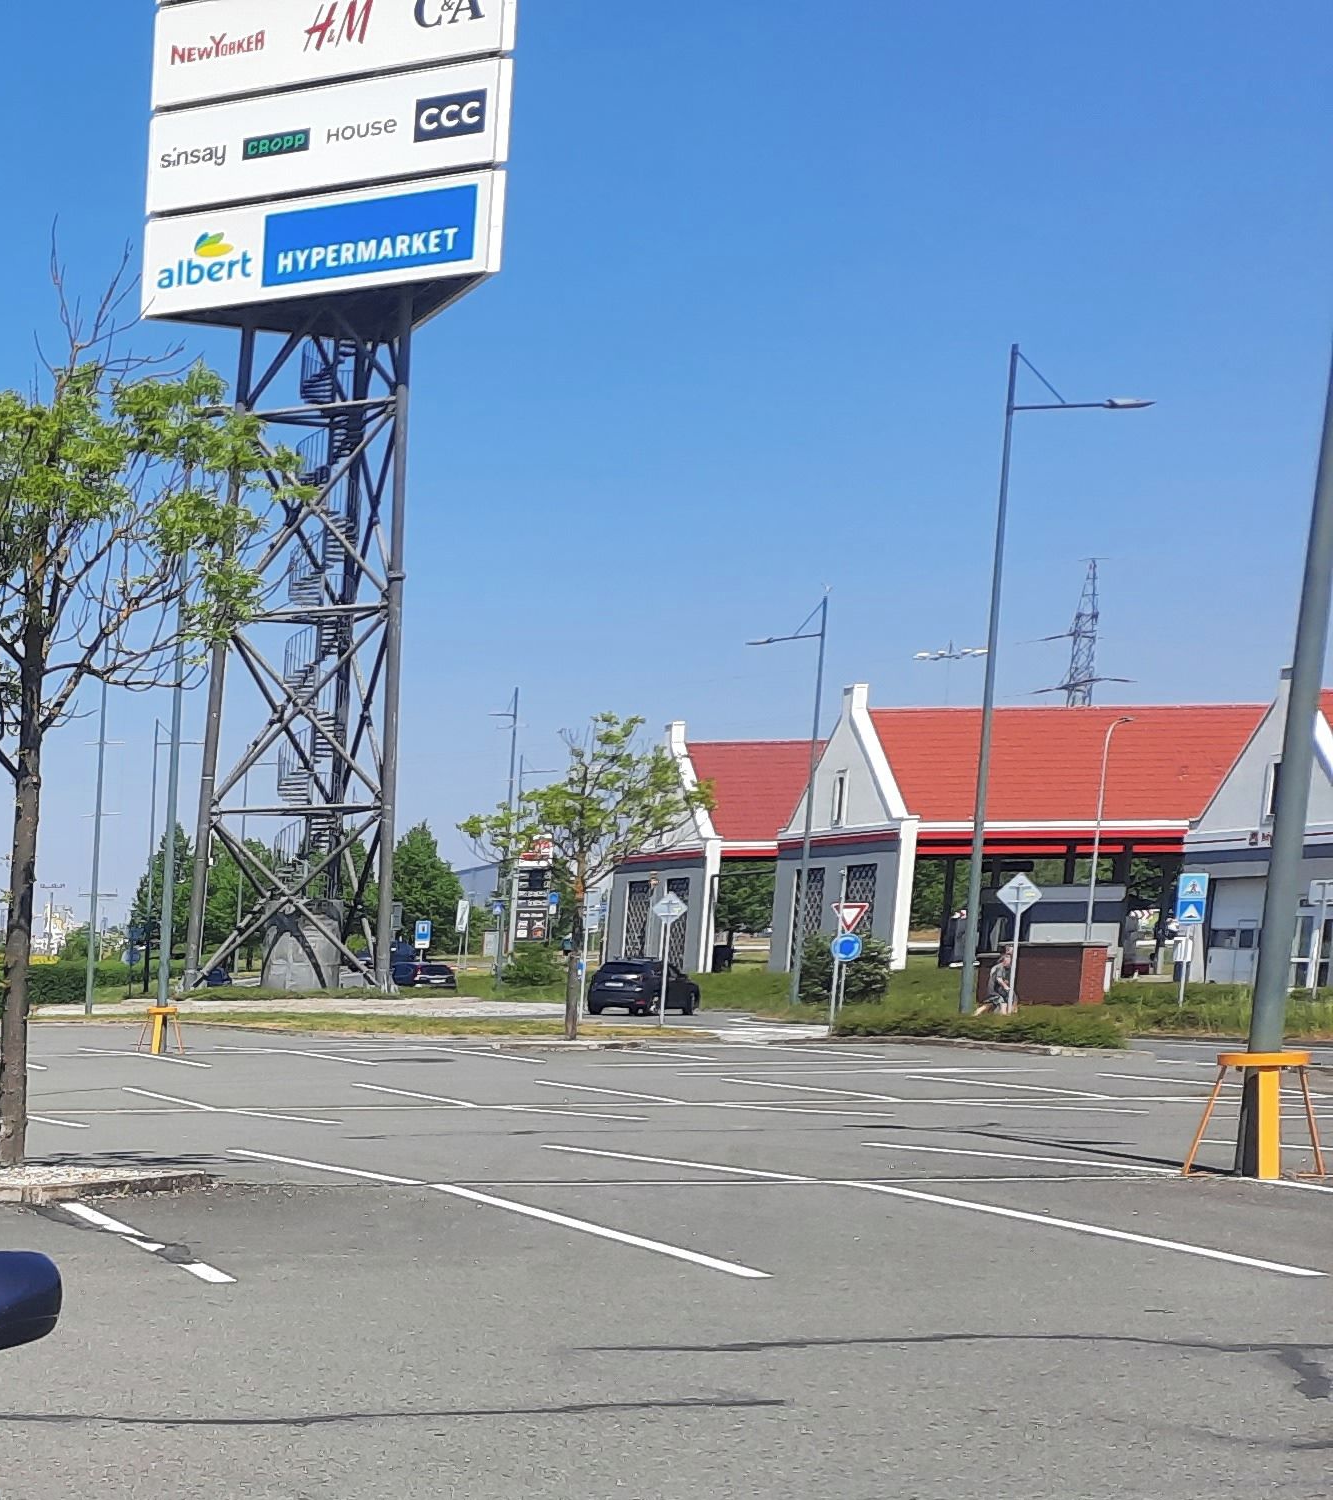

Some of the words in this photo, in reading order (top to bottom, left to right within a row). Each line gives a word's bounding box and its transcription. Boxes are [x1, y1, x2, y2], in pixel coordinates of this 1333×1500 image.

[304, 0, 373, 52] H&M
[414, 0, 485, 28] C&A
[420, 101, 481, 131] CCC
[160, 144, 227, 168] sinsay
[247, 133, 306, 156] CROPP
[277, 227, 458, 275] HYPERMARKET
[157, 251, 253, 289] albert
